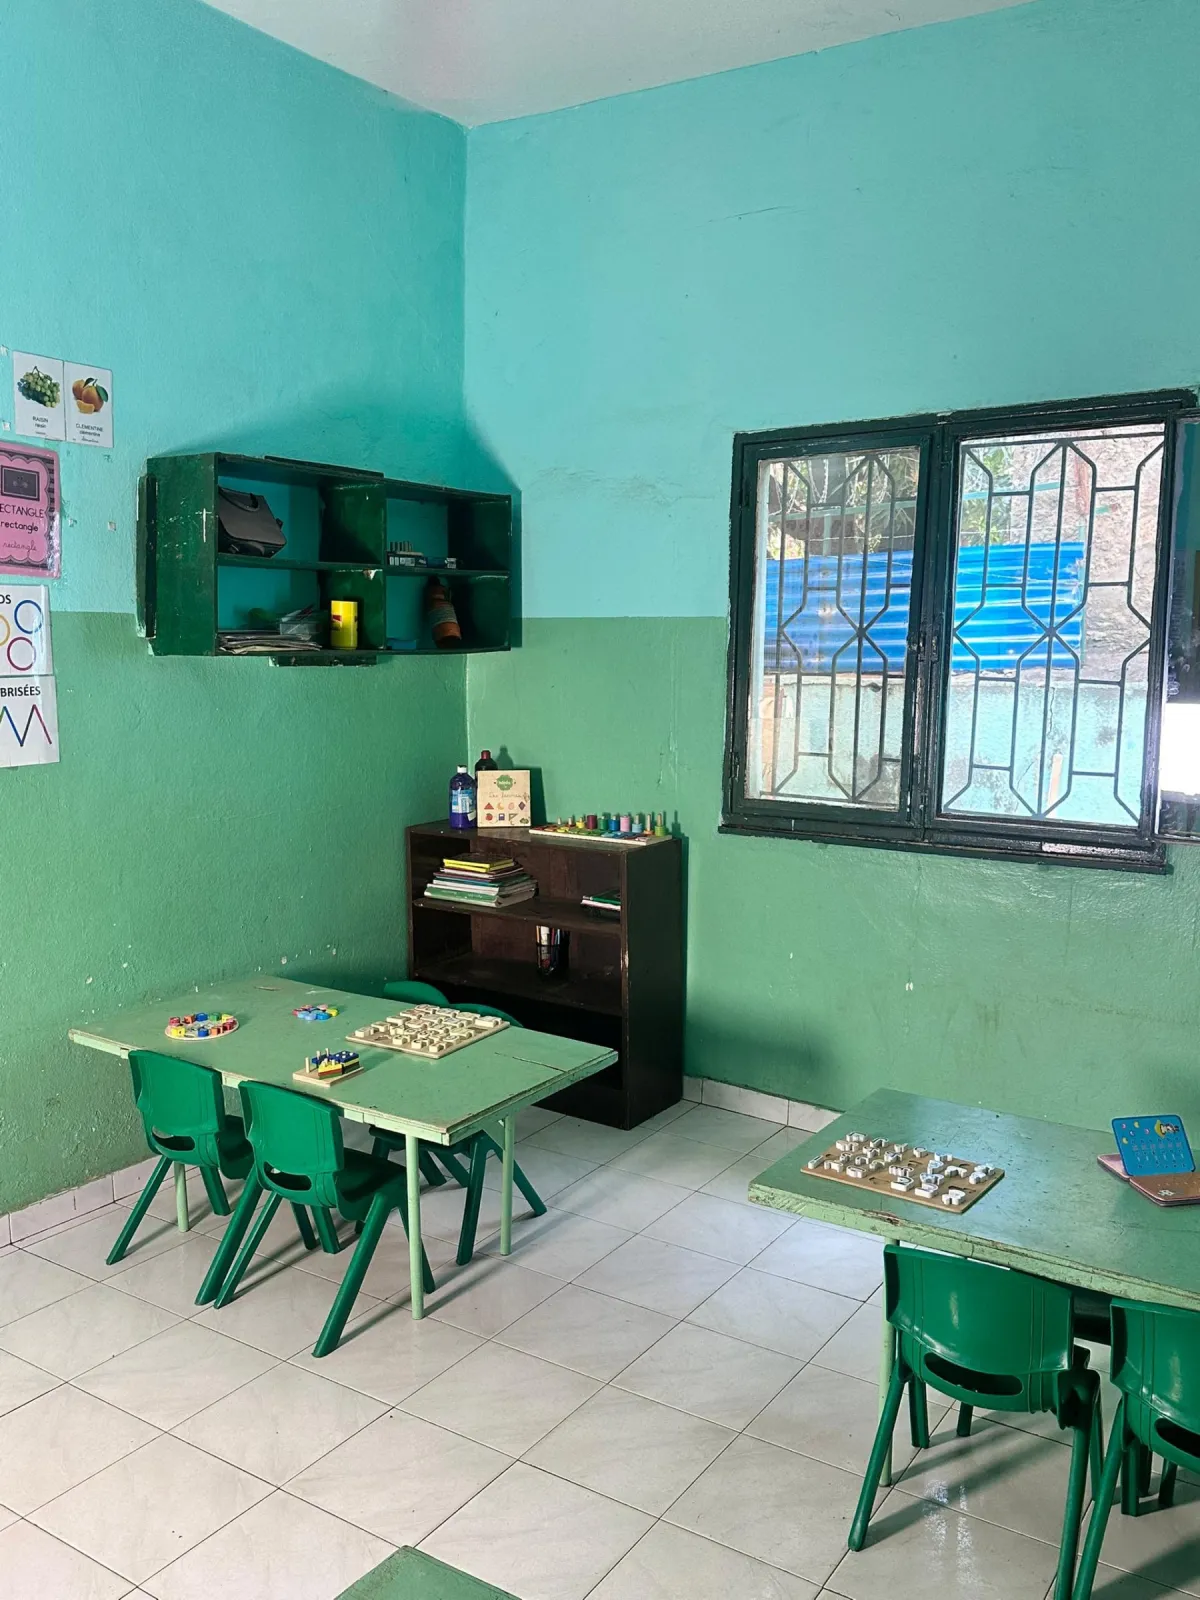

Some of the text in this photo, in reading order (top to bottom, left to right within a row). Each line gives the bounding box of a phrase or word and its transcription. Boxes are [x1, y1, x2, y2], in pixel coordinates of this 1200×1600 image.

[1, 521, 38, 534] rectangle
[3, 540, 36, 557] rectangle
[0, 684, 41, 697] BRISÉES
